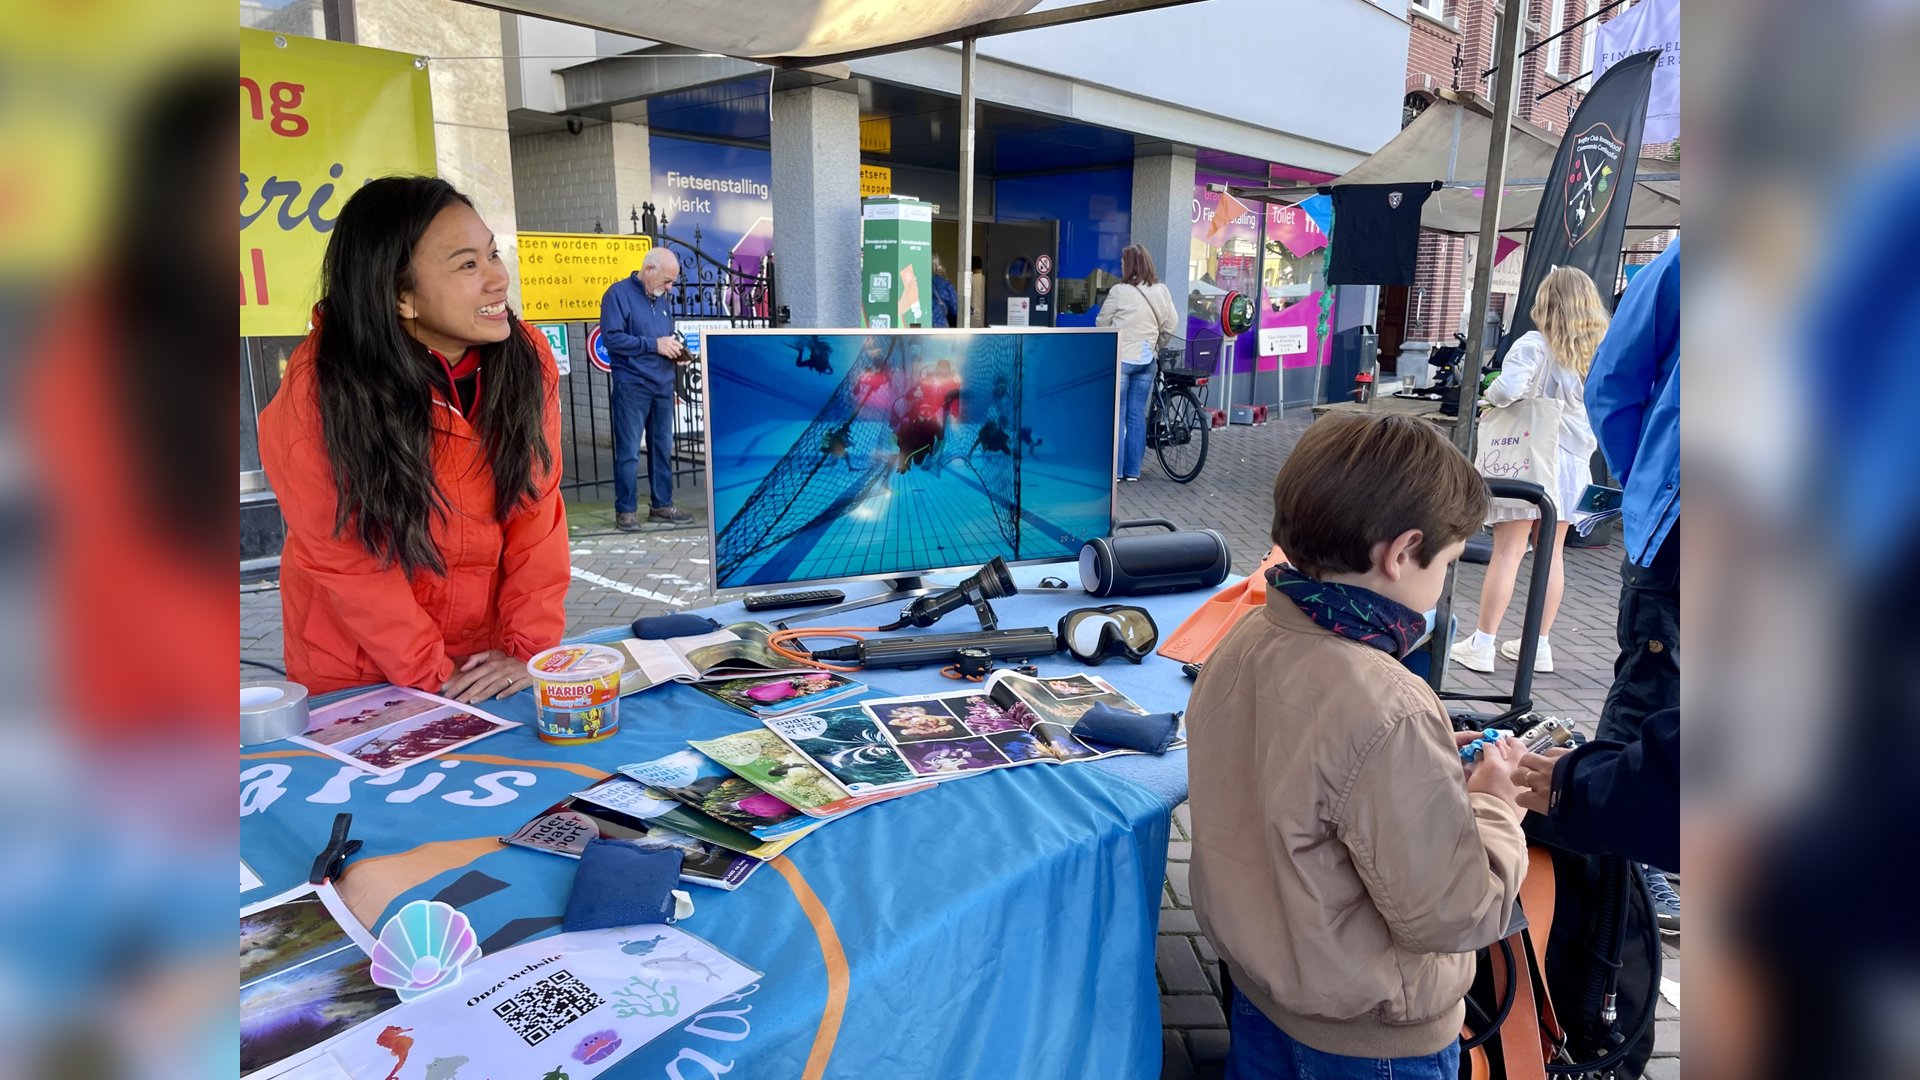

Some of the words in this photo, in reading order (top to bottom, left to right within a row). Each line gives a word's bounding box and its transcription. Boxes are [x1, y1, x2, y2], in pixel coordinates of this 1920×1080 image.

[667, 171, 768, 200] Fietsenstalling
[860, 184, 890, 194] tappen
[669, 195, 711, 213] Markt
[1273, 206, 1295, 225] Toilet
[552, 240, 598, 250] worden
[607, 240, 620, 250] op
[624, 241, 648, 251] last
[528, 253, 544, 264] de
[555, 253, 619, 264] Gemeente
[535, 301, 550, 310] de
[1491, 438, 1501, 446] IK
[1501, 437, 1520, 446] BEN
[547, 684, 595, 697] HARIBO
[775, 717, 814, 727] onder
[784, 720, 822, 730] water
[523, 815, 566, 844] onder
[541, 815, 582, 845] water
[466, 981, 508, 1007] Onze
[507, 955, 562, 981] website
